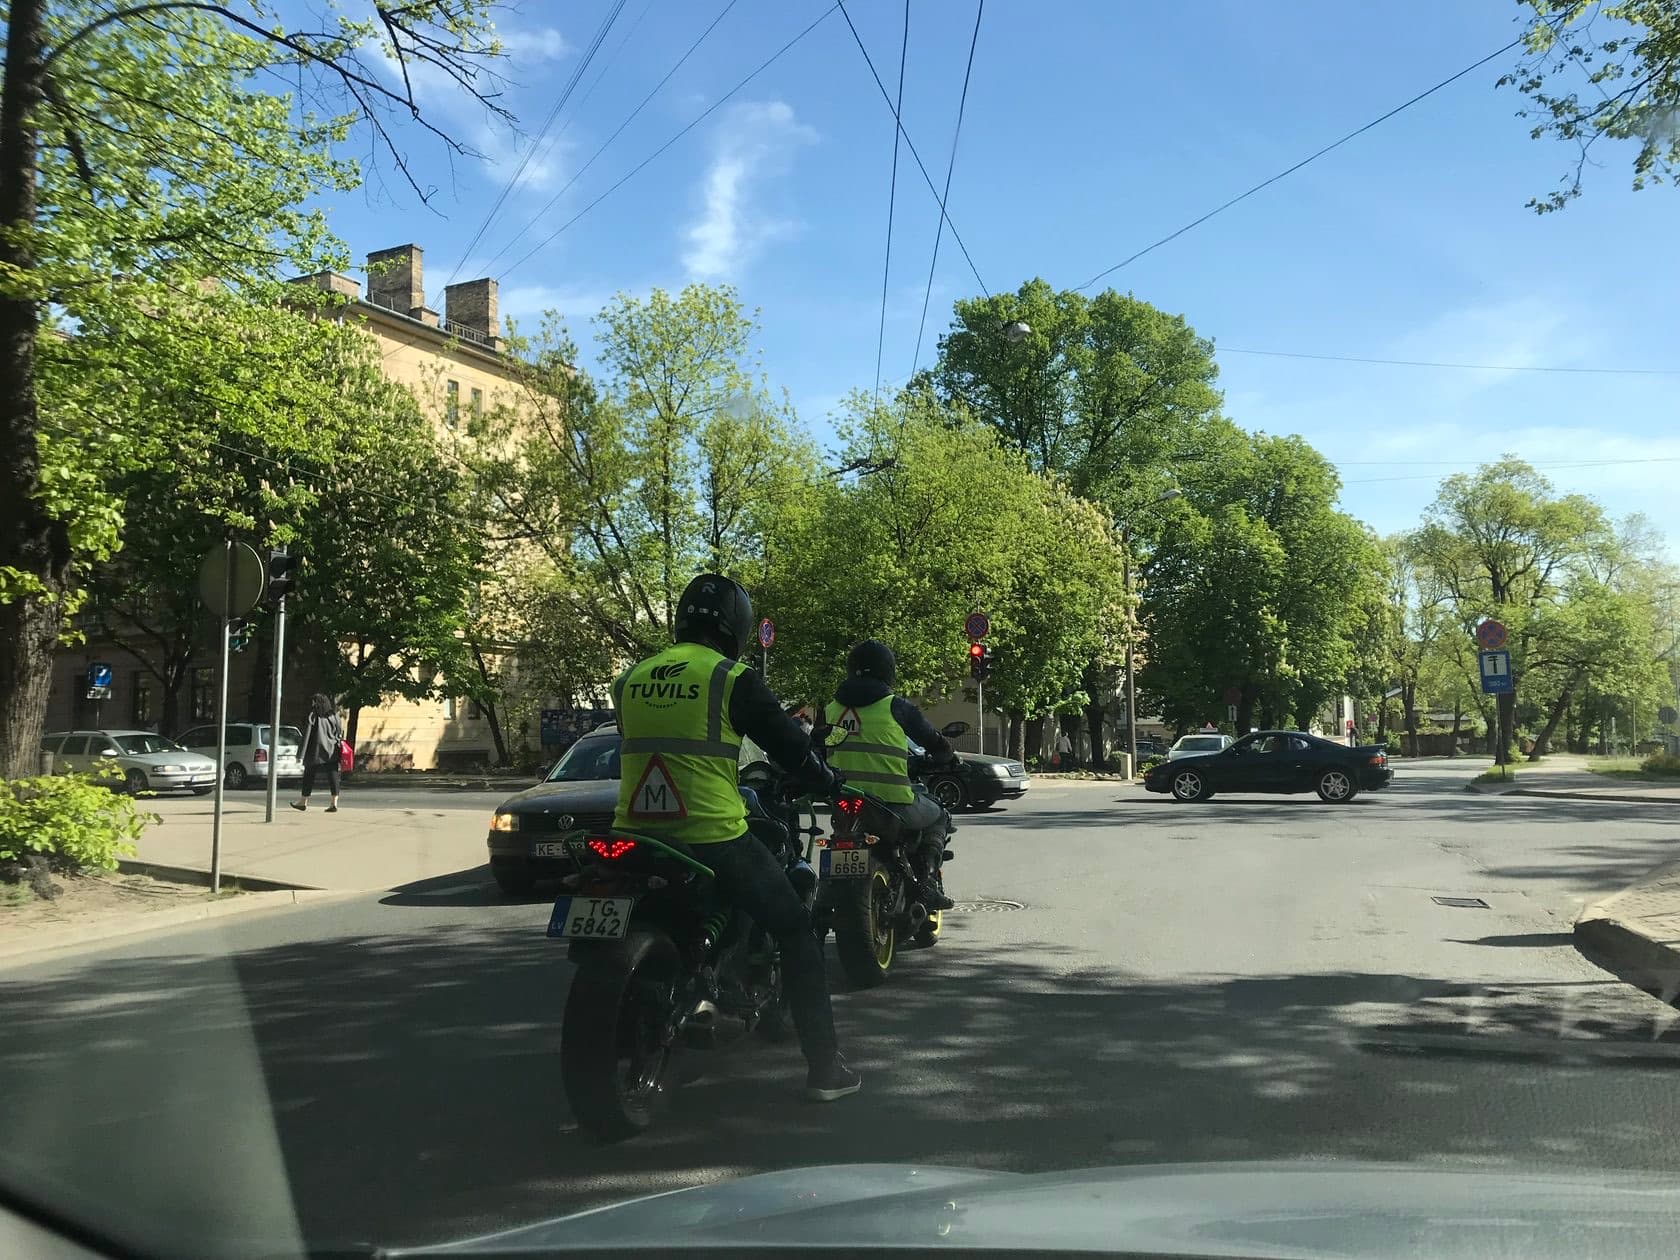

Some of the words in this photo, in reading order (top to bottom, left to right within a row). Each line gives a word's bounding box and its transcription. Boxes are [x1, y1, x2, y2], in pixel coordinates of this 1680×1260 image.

[629, 683, 700, 700] TUVILS
[842, 719, 856, 732] M
[645, 784, 667, 811] M
[842, 851, 859, 862] TG
[834, 862, 866, 874] 6665
[571, 917, 621, 937] 5842
